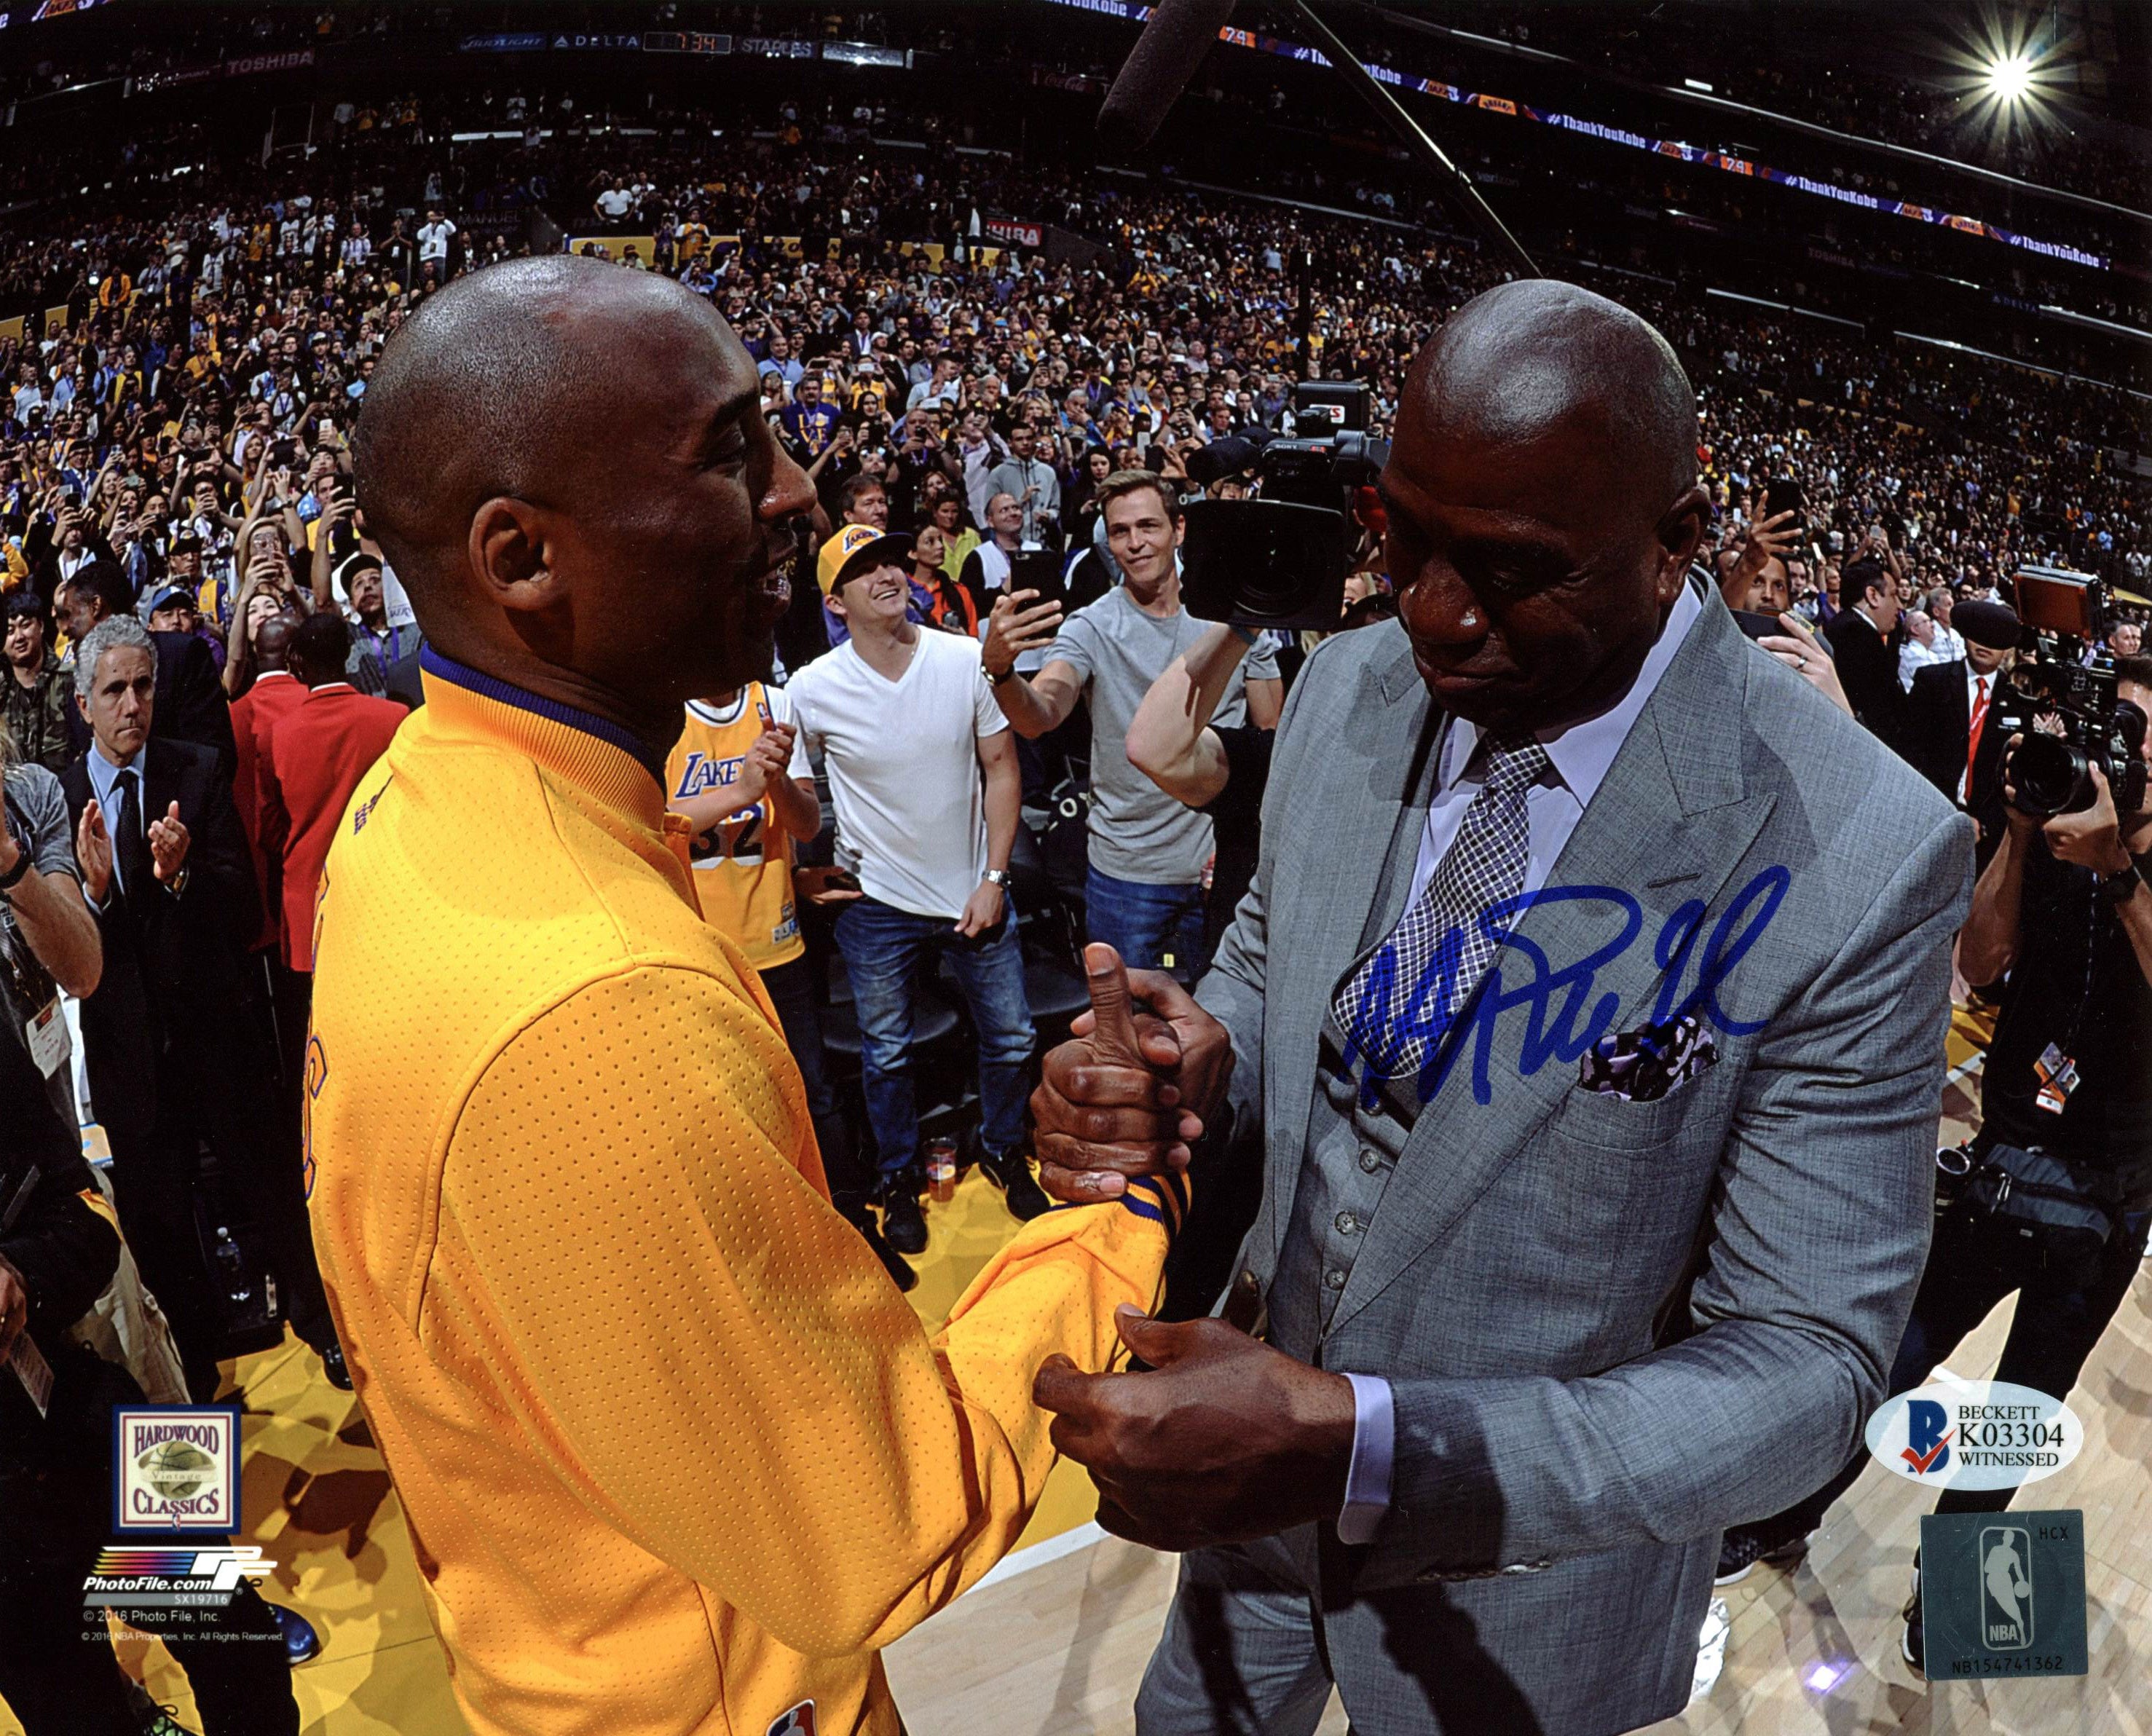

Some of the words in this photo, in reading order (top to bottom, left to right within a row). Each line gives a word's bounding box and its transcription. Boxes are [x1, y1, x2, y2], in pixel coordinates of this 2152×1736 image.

[575, 35, 639, 47] DELTA
[741, 39, 812, 57] STAPLES
[226, 50, 314, 74] TOSHIBA
[1547, 113, 1646, 149] #ThankYouKobe
[1785, 175, 1877, 209] #ThankYouKobe
[2010, 234, 2100, 268] #ThankYouKobe
